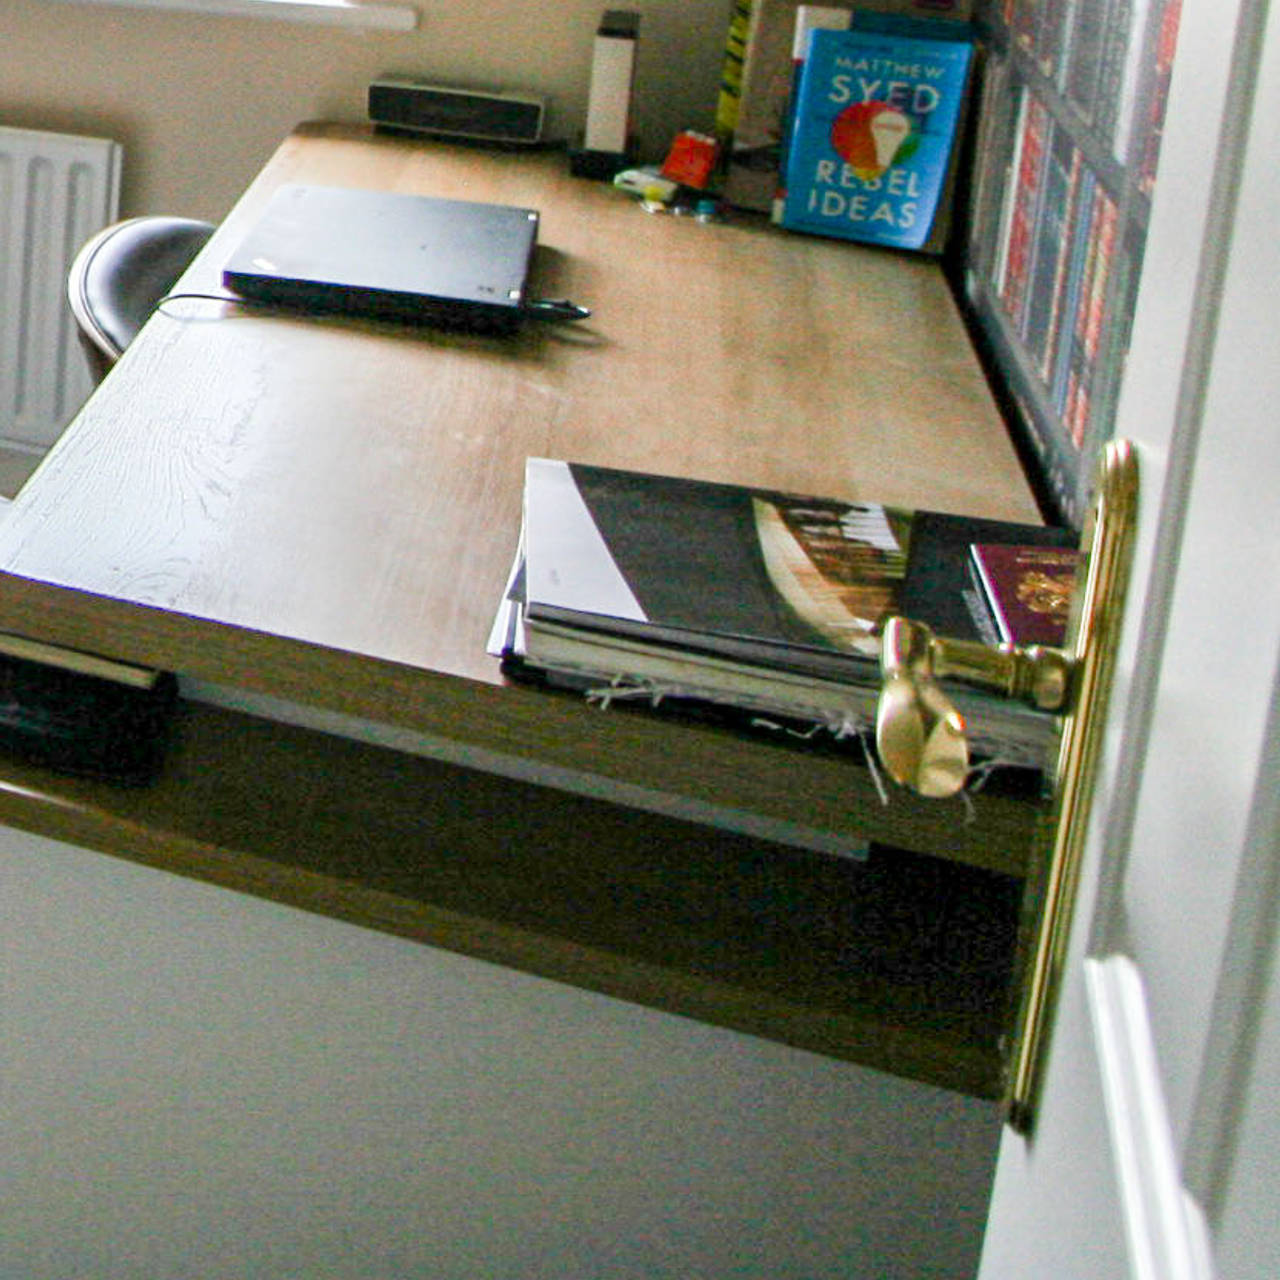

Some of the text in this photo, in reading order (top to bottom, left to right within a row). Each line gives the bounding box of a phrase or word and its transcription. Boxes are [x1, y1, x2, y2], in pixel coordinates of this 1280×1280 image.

[836, 57, 945, 79] MATTHEW
[828, 74, 941, 113] SYED
[816, 160, 922, 198] REBEL
[807, 189, 919, 228] IDEAS
